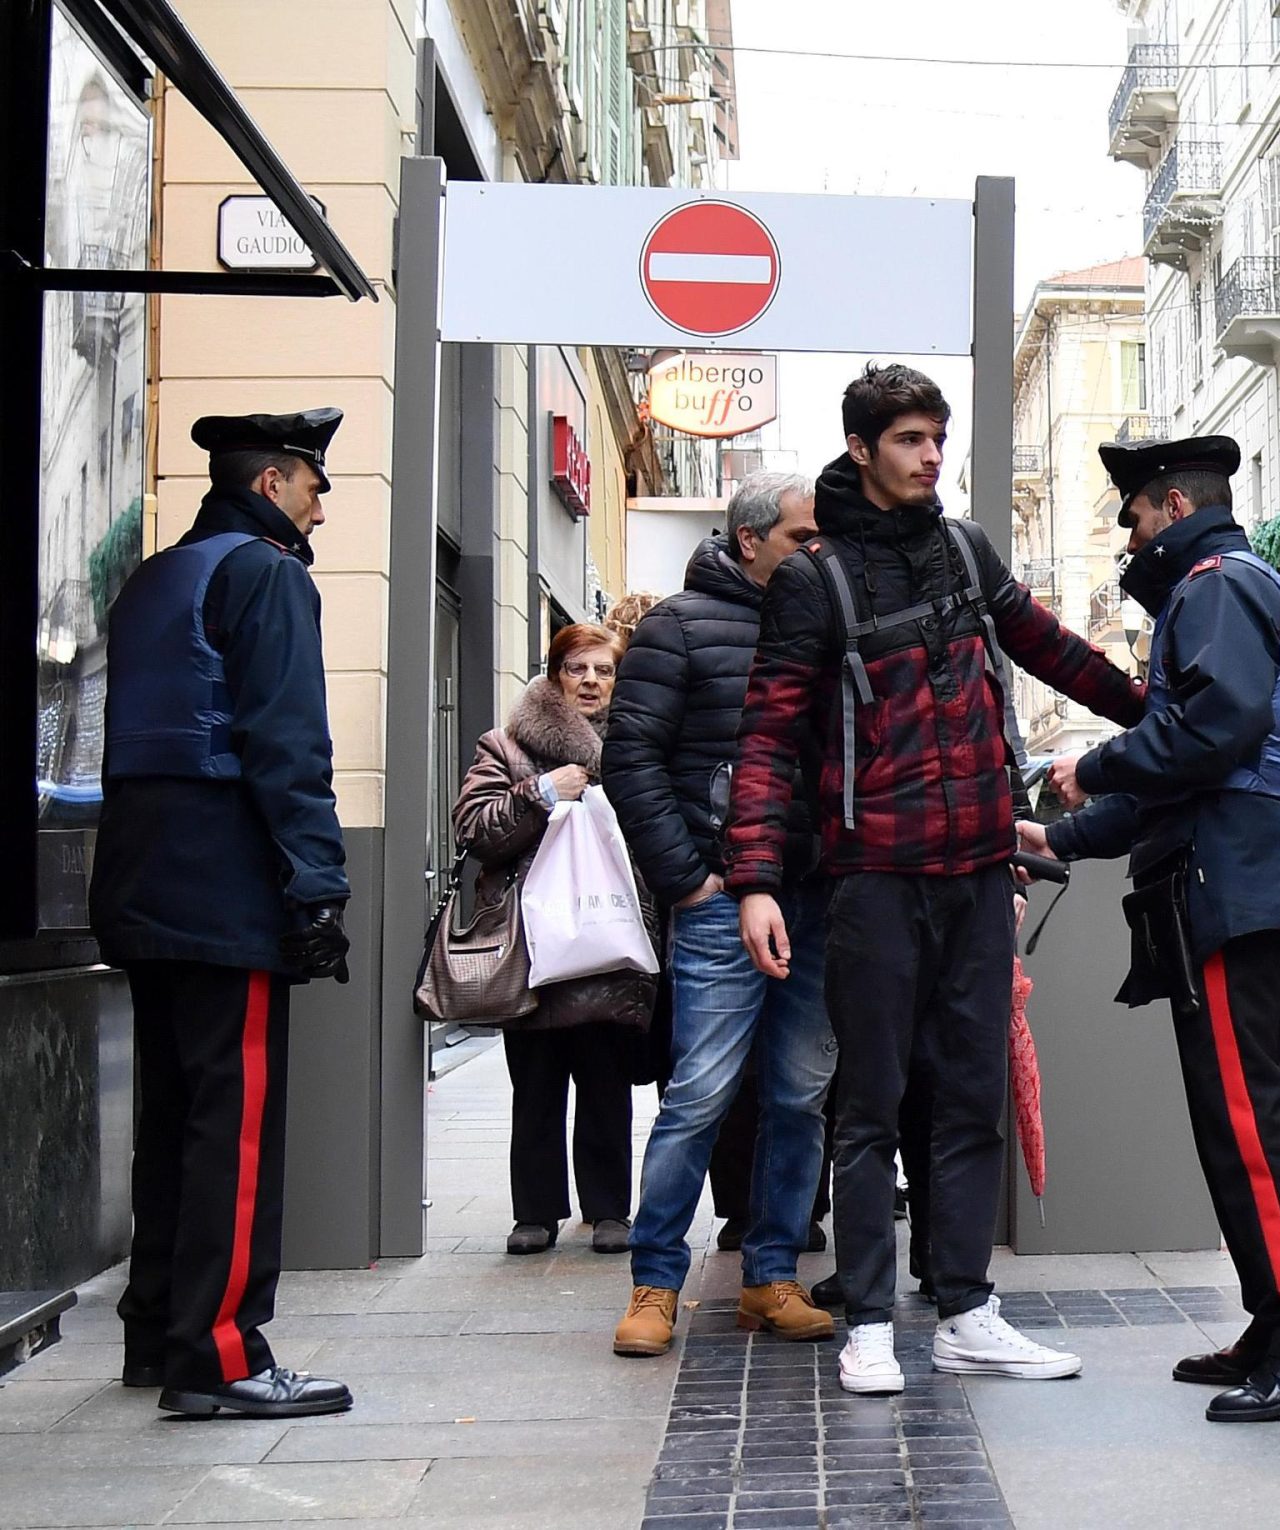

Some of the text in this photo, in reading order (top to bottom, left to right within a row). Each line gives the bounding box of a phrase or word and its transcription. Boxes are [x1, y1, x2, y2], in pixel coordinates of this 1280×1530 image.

[257, 210, 287, 228] VIA
[236, 236, 306, 255] GAUDIO
[665, 359, 764, 389] albergo
[674, 388, 753, 426] buffo
